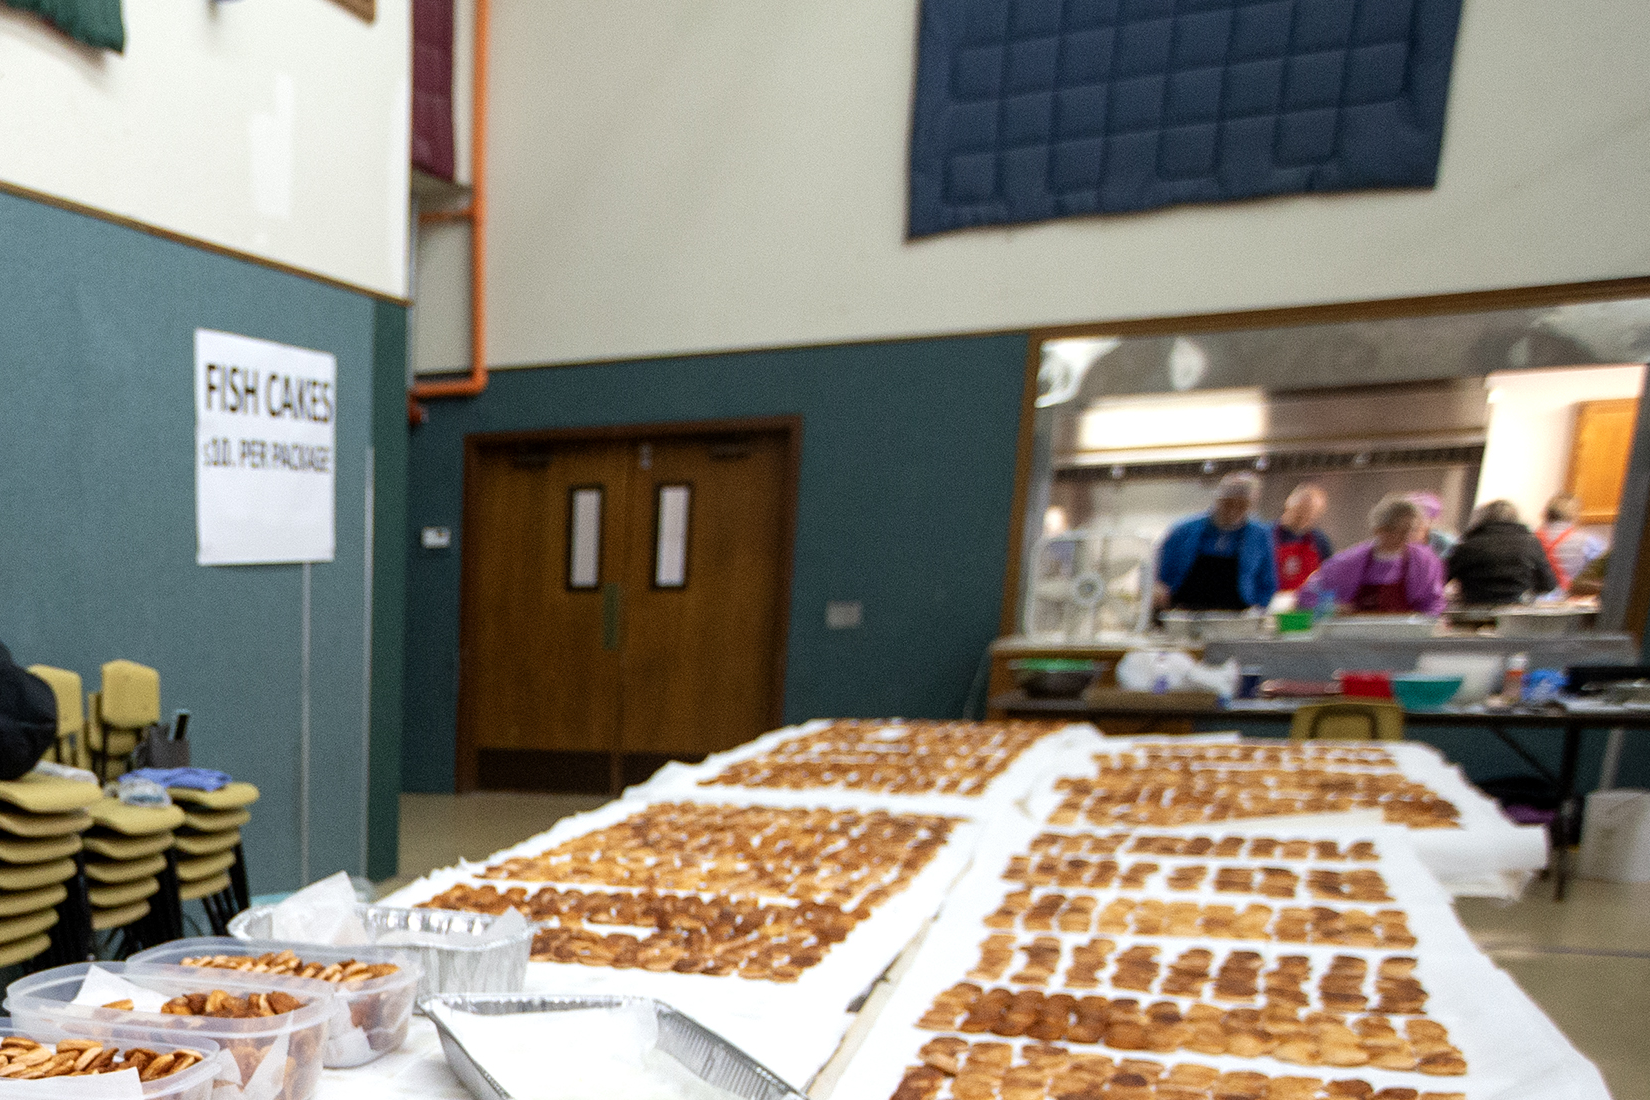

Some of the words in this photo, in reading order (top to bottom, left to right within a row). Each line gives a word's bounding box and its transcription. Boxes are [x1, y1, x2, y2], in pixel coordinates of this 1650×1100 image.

[206, 362, 260, 416] FISH
[265, 372, 333, 424] CAKES
[239, 439, 268, 469] PER
[272, 441, 331, 474] PACKAGE
